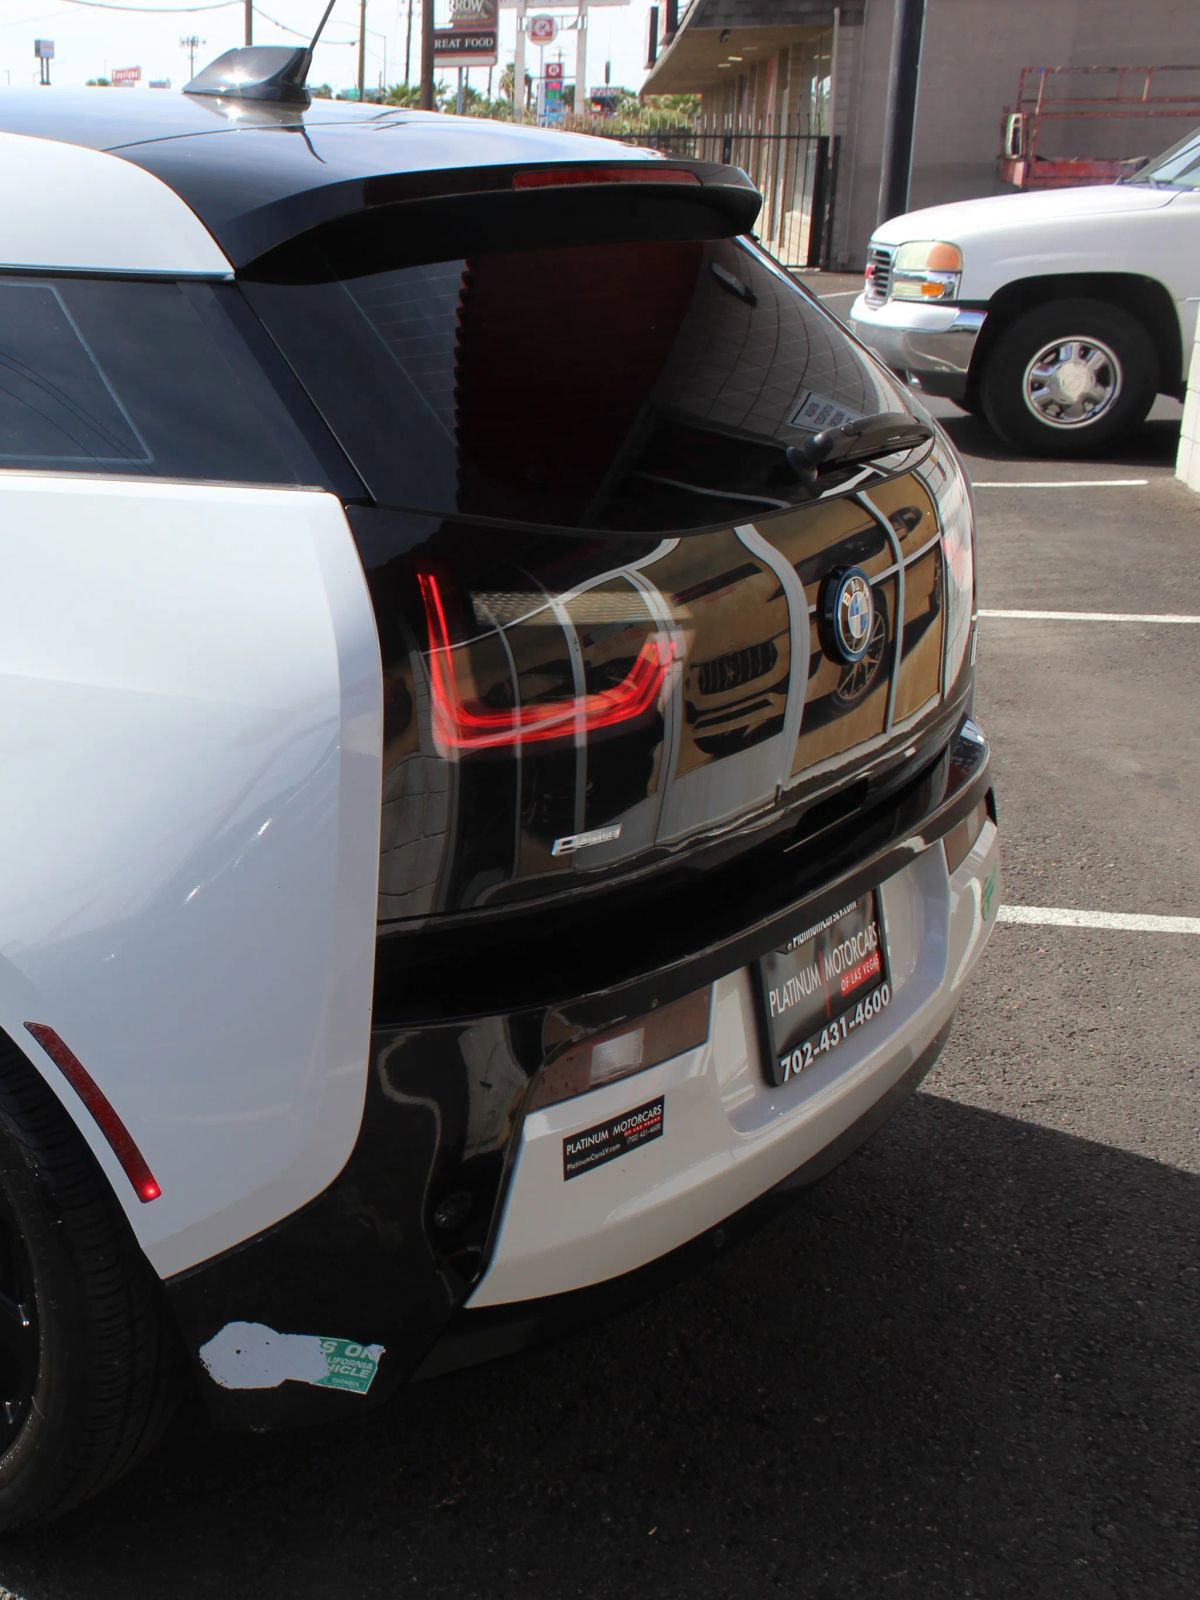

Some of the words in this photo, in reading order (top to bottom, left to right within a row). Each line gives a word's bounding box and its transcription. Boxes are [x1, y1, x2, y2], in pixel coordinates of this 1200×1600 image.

[464, 37, 494, 48] FOOD
[769, 963, 822, 1018] PLATINUM
[824, 921, 878, 981] MOTORCARS
[841, 975, 850, 991] OF
[851, 968, 862, 986] LAS
[863, 952, 880, 973] VEGAS
[781, 984, 890, 1082] 702-431-4600
[566, 1130, 609, 1156] PLATINUM
[613, 1104, 662, 1136] MOTORCARS
